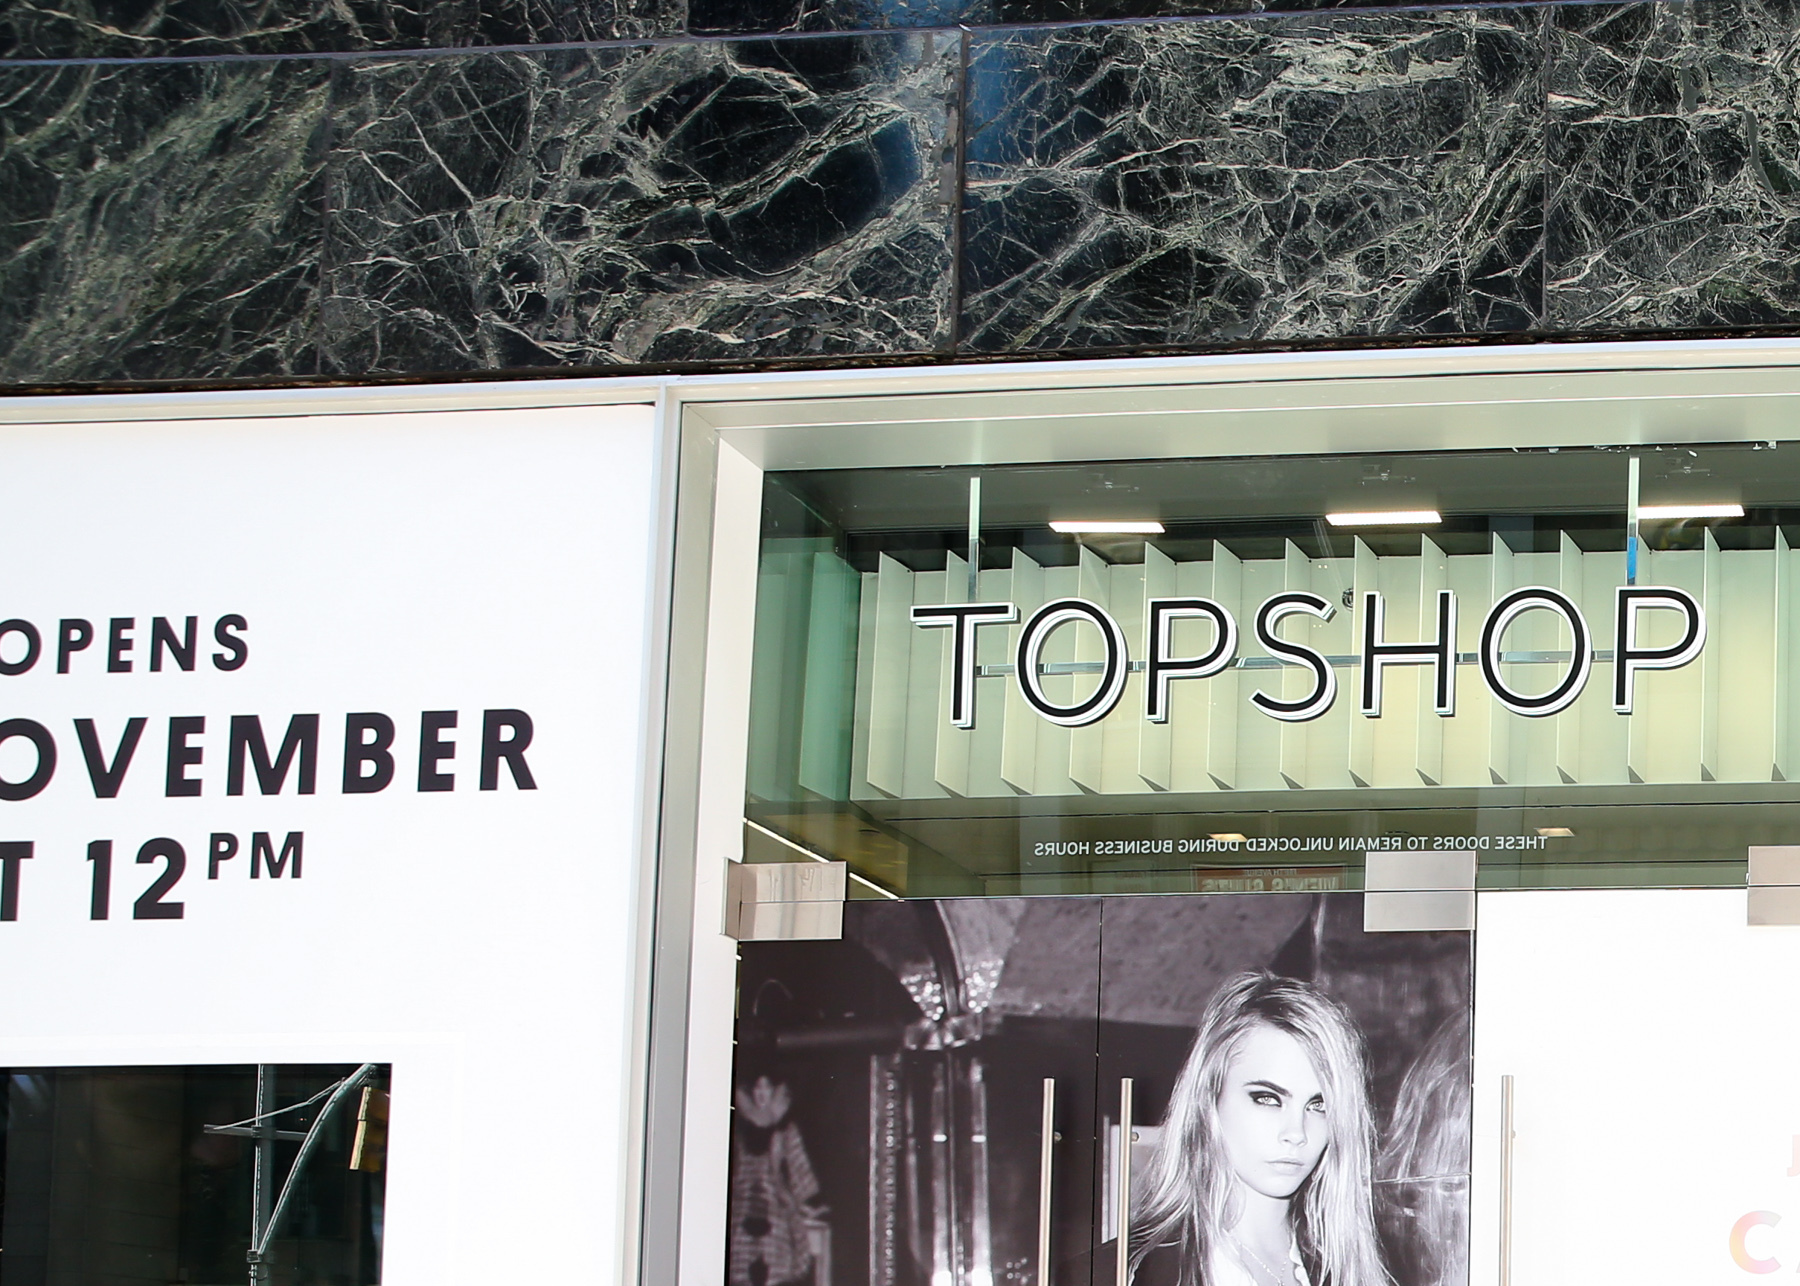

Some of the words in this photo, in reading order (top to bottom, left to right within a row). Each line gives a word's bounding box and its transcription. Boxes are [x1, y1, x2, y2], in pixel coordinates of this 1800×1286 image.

[0, 613, 249, 676] OPENS
[910, 584, 1707, 729] TOPSHOP
[0, 708, 538, 802] OVEMBER
[86, 831, 304, 921] 12PM
